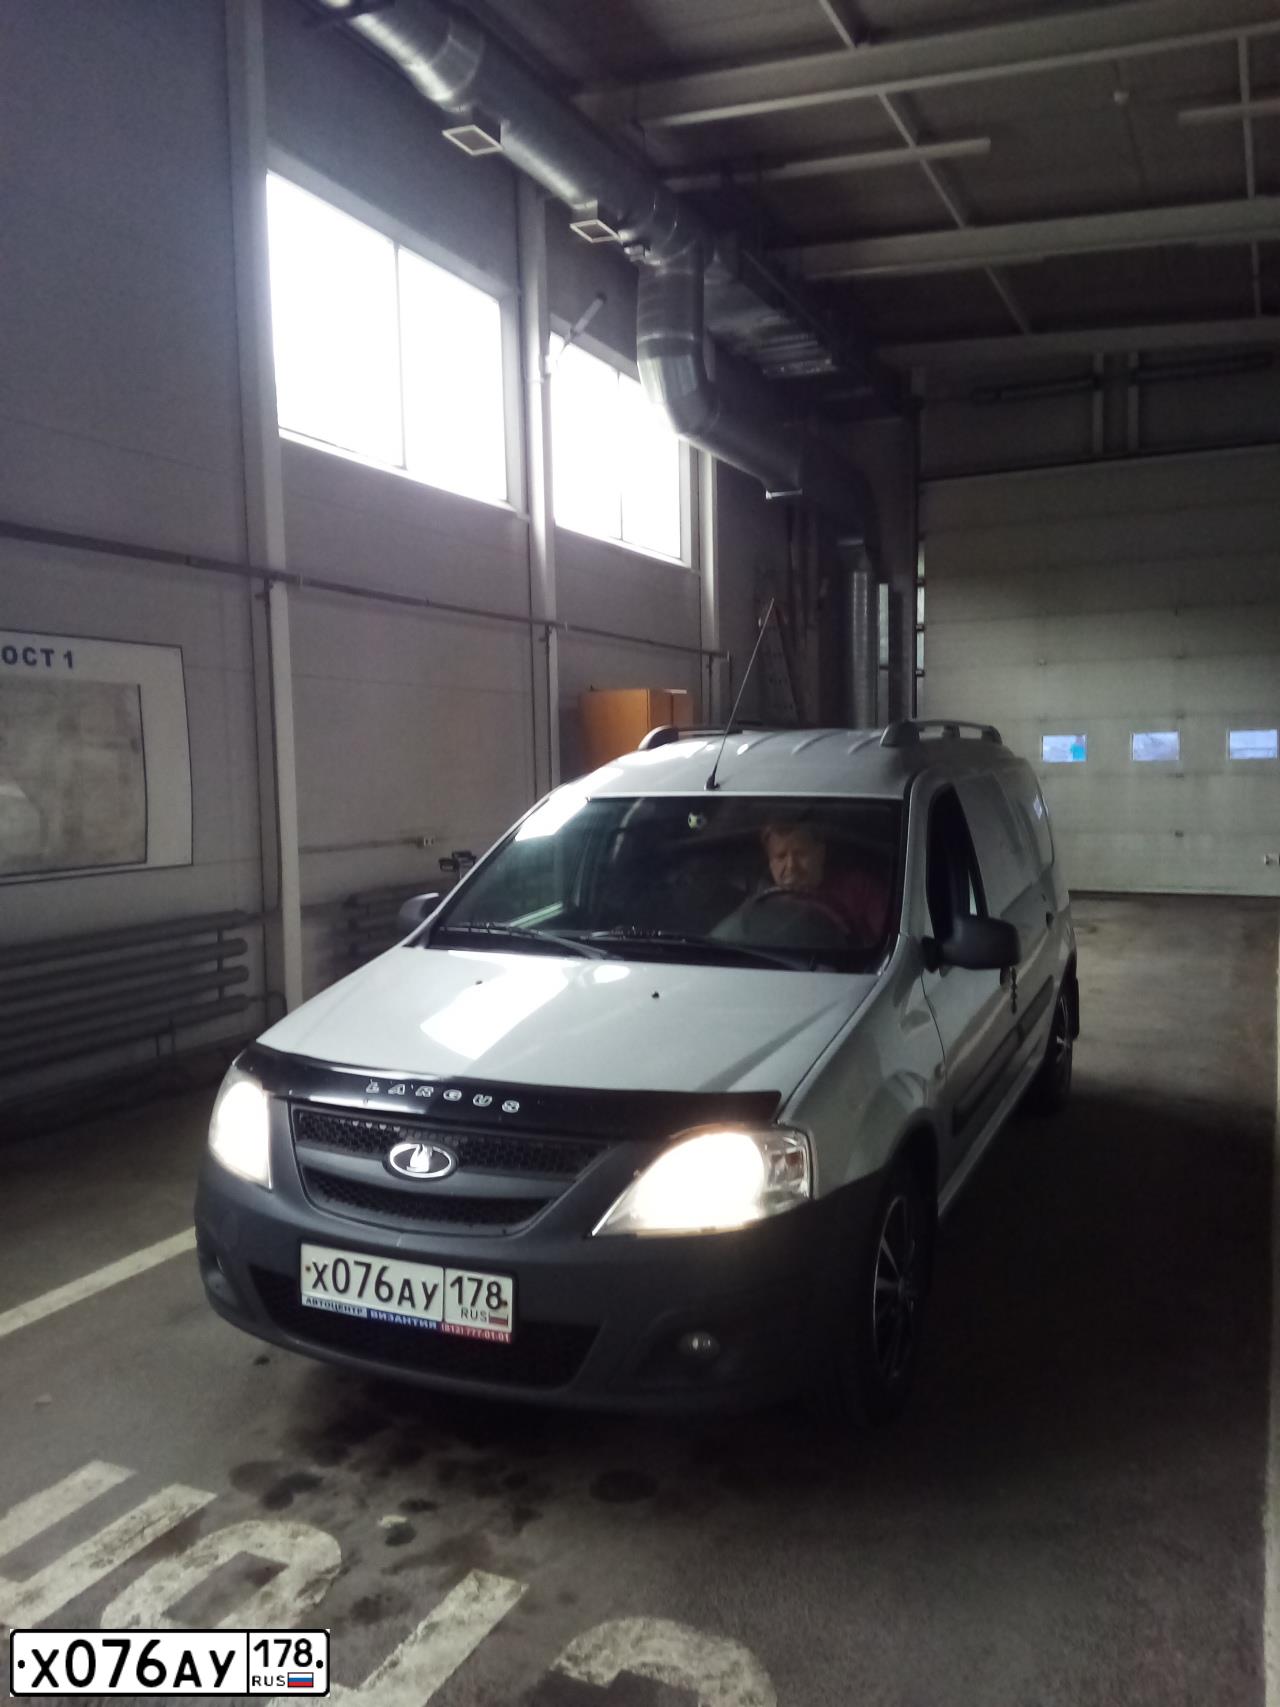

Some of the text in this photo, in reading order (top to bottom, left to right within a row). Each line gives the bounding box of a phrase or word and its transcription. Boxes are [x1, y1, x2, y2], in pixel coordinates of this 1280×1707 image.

[1, 645, 73, 669] ОСТ 1
[311, 1257, 502, 1311] Х076АУ 178
[305, 1296, 364, 1318] АВТОЦЕНТР
[460, 1305, 488, 1323] RUS
